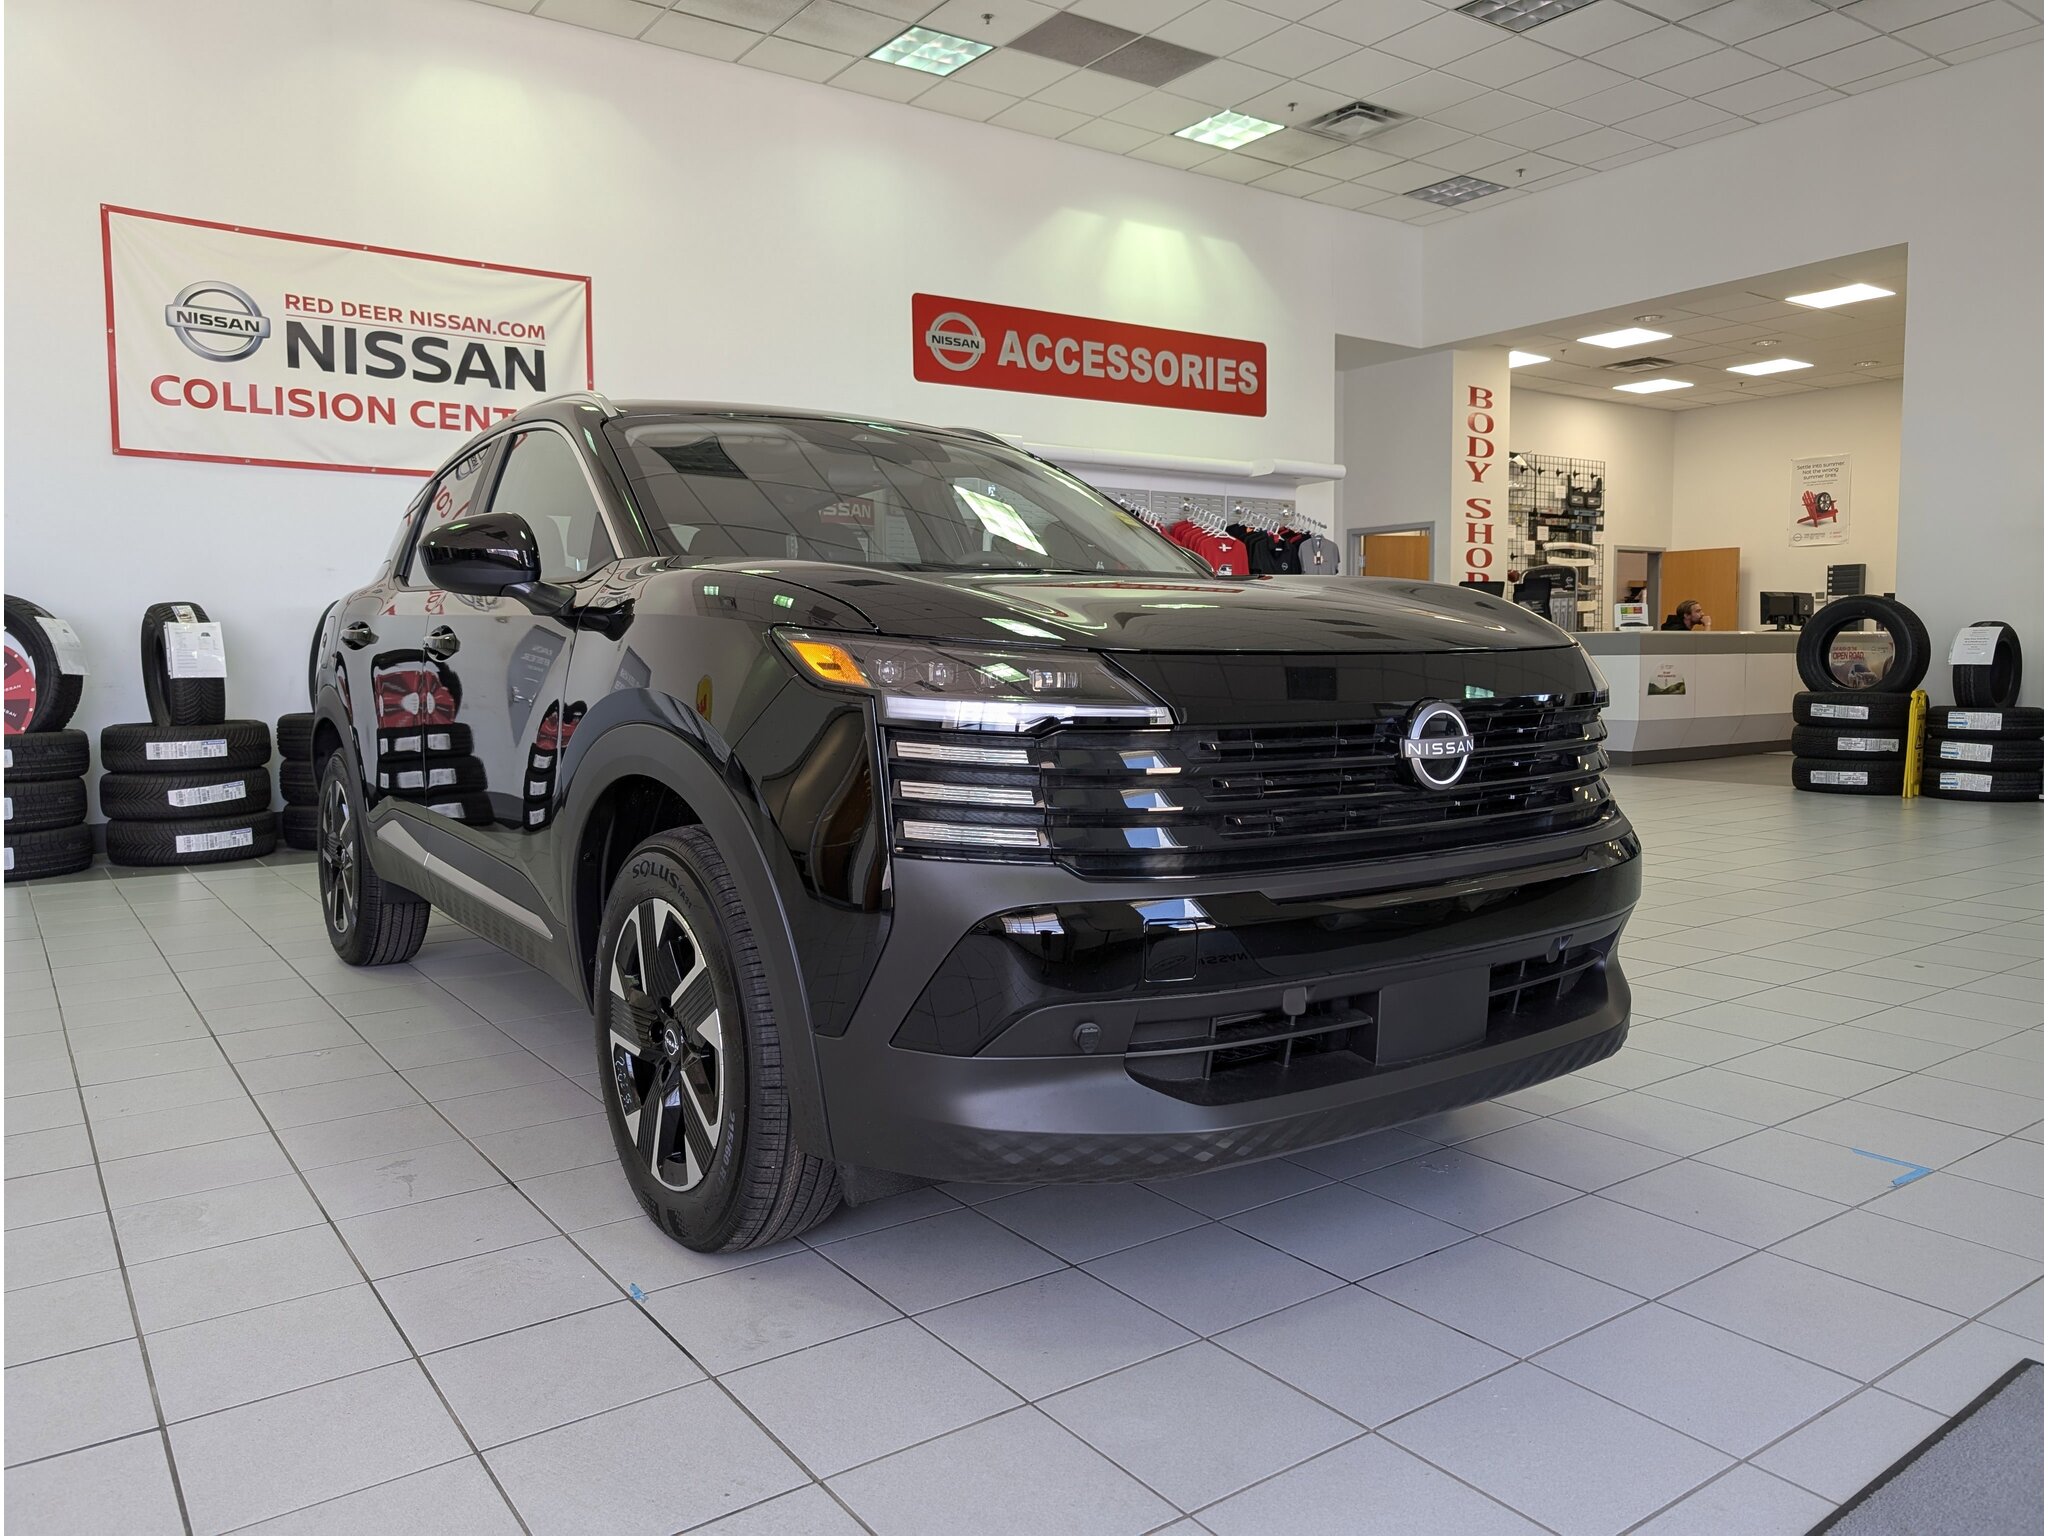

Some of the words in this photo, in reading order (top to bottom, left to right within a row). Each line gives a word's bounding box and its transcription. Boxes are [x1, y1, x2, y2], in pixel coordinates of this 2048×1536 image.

[176, 310, 260, 333] NISSAN
[284, 293, 334, 314] RED
[341, 301, 403, 323] DEER
[410, 310, 546, 340] NISSAN.COM
[286, 320, 547, 393] NISSAN
[931, 334, 980, 350] NISSAN
[996, 330, 1259, 395] ACCESSORIES
[150, 374, 397, 426] COLLISION
[410, 400, 517, 432] CENT
[1465, 385, 1495, 483] BODY
[818, 502, 871, 519] SSAN
[1408, 738, 1474, 756] NISSAN
[632, 860, 680, 889] SOLUS
